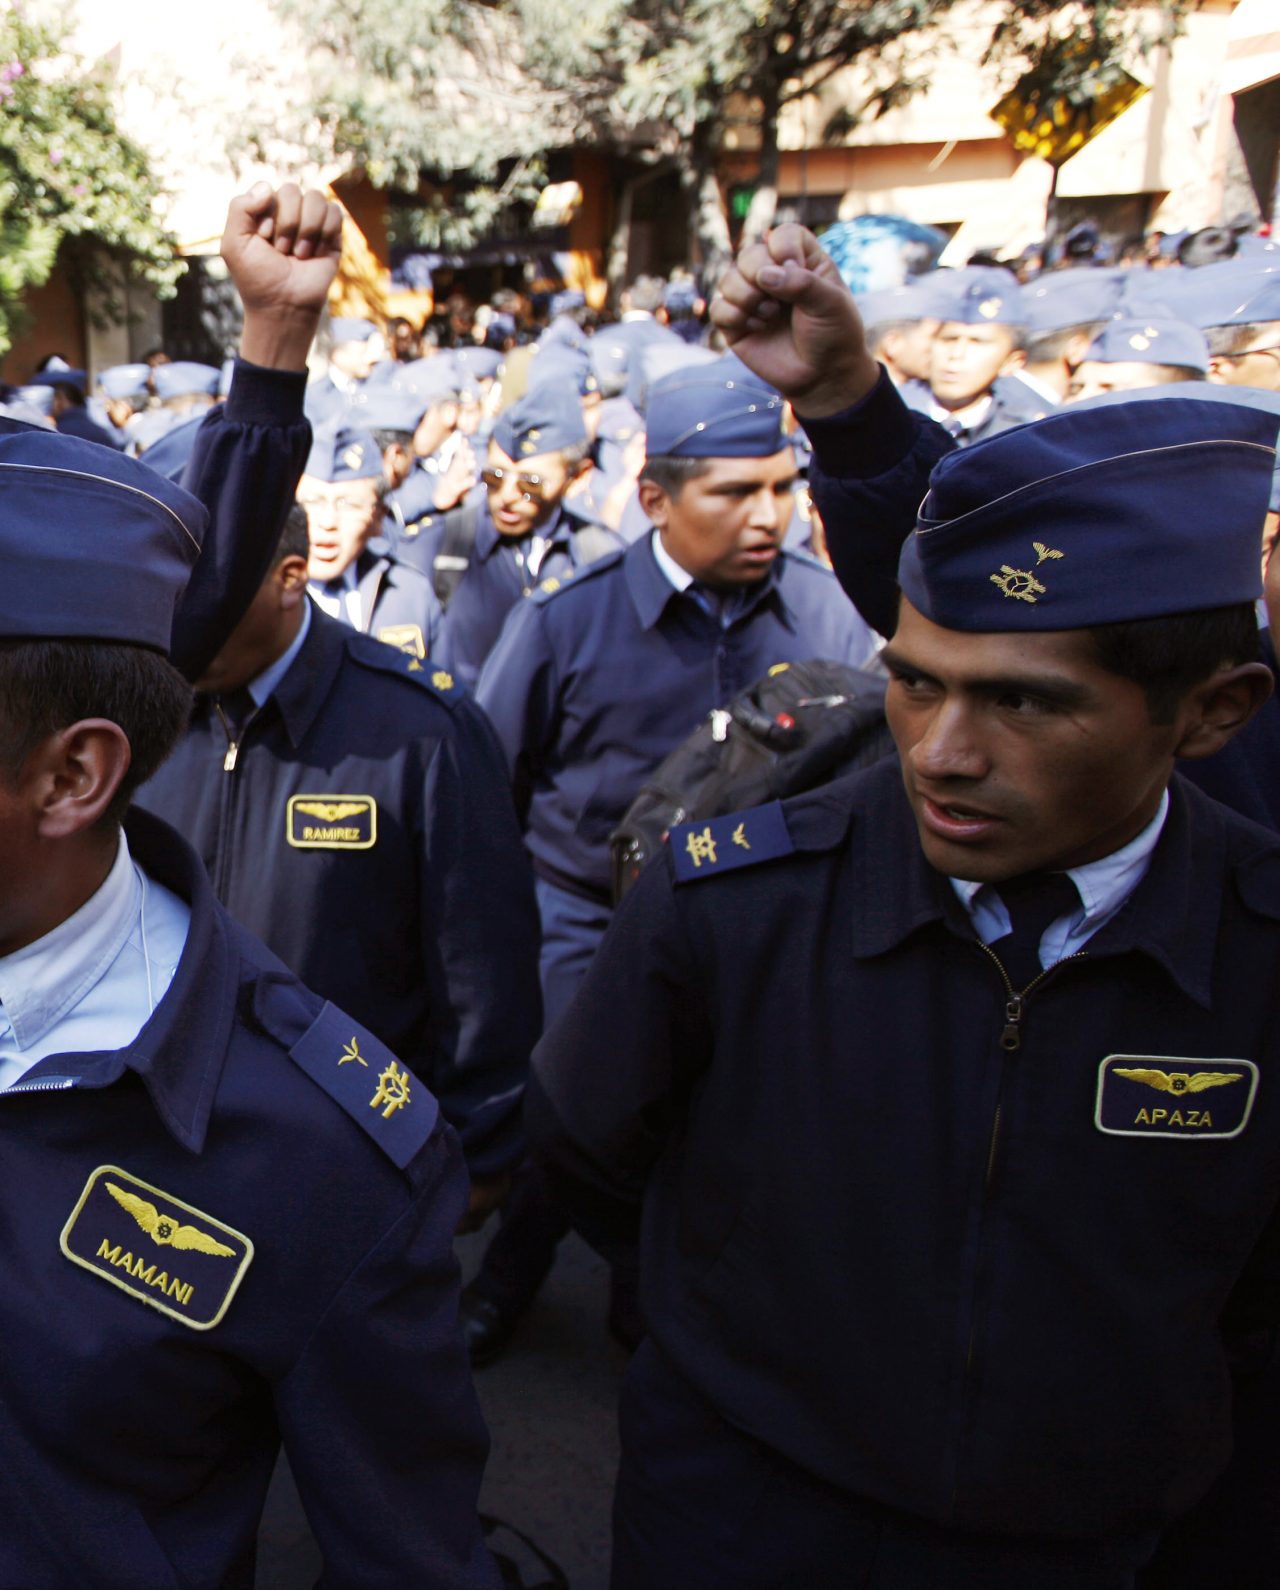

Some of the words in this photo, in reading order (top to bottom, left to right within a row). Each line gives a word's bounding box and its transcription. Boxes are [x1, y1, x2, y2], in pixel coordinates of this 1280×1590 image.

[303, 827, 360, 841] RAMIREZ
[1134, 1108, 1213, 1127] APAZA
[96, 1239, 195, 1305] MAMANI
